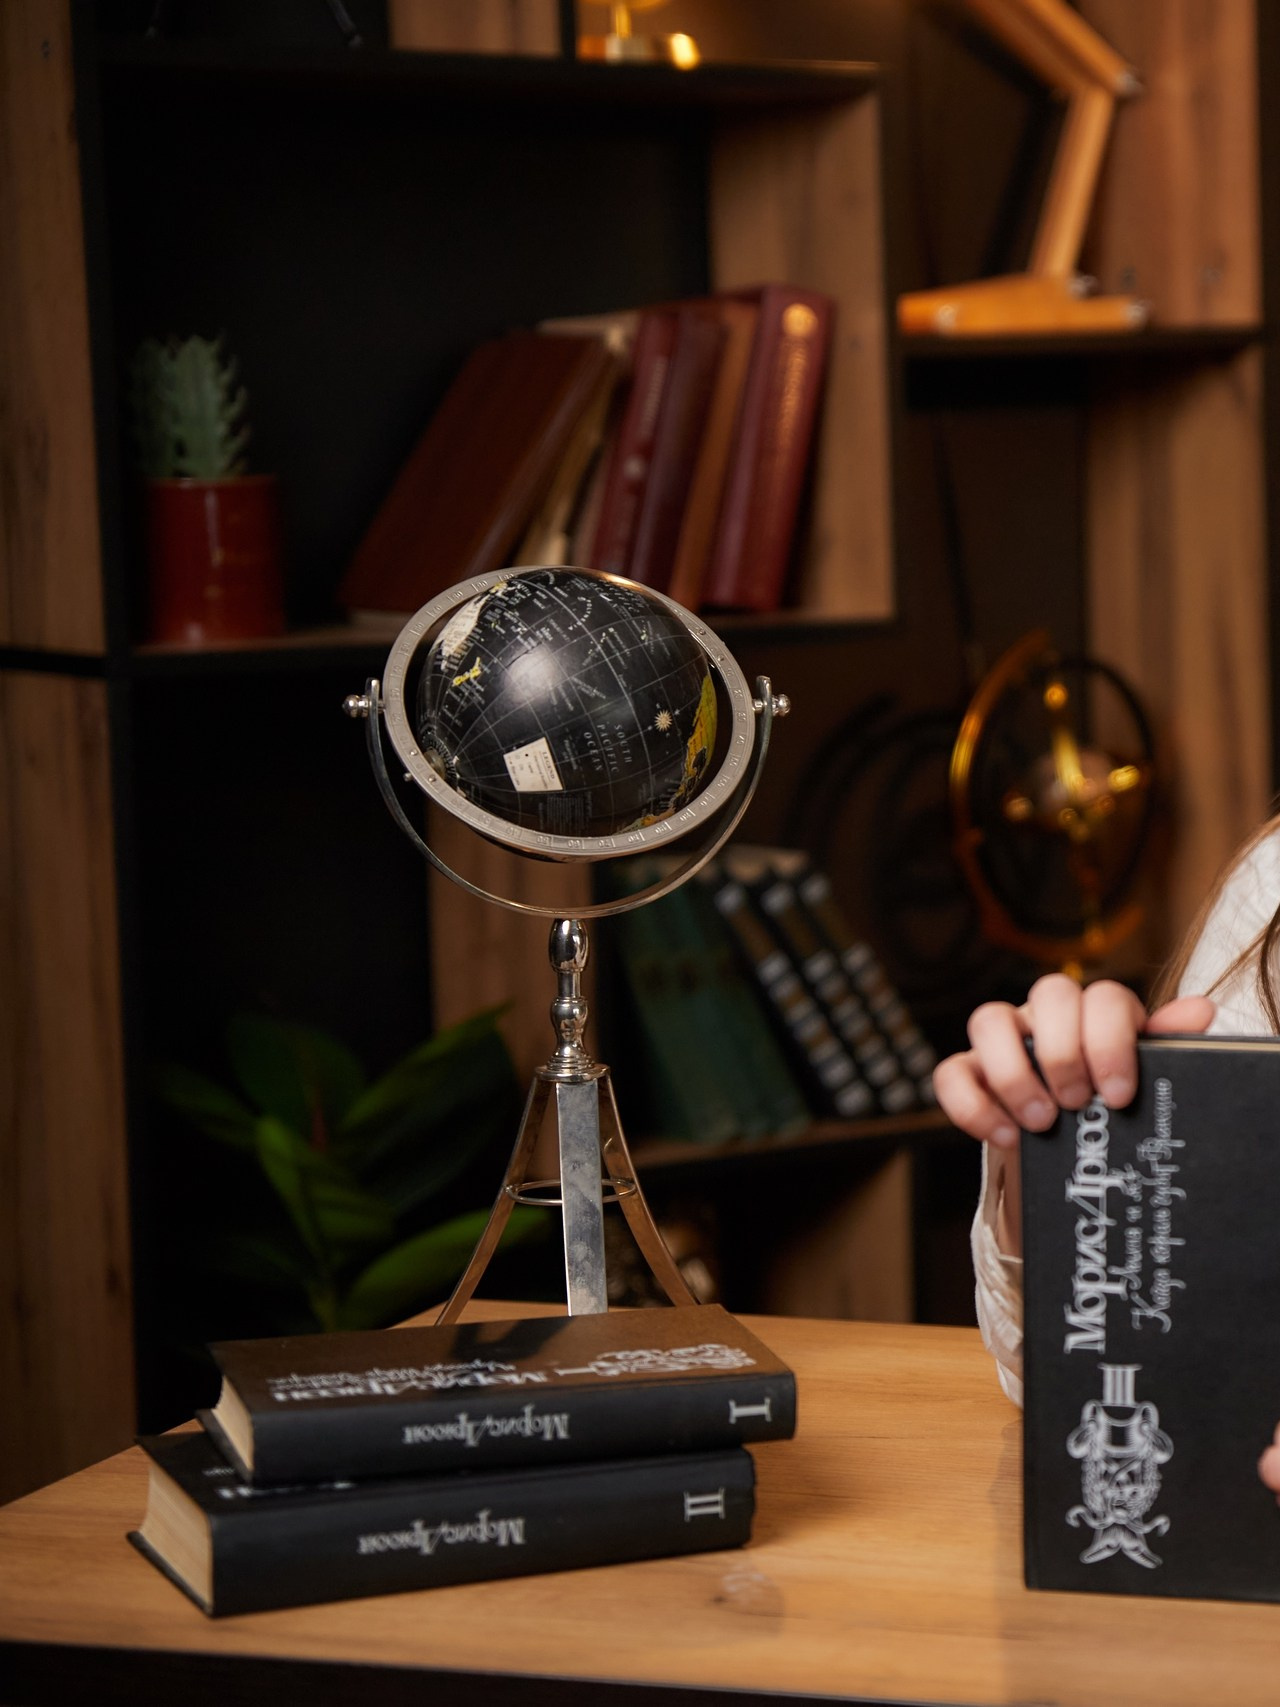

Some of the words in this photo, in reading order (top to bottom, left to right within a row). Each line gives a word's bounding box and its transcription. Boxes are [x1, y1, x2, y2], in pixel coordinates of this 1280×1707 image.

[583, 731, 603, 771] OCEAN
[596, 723, 620, 774] PACIFIC
[613, 723, 633, 764] SOUTH
[542, 751, 555, 781] LEGEND
[1063, 1094, 1127, 1223] Дрюо
[1063, 1216, 1127, 1355] Морис
[401, 1412, 491, 1447] Дрюон
[482, 1404, 570, 1442] Морис
[356, 1517, 448, 1556] Дрюон
[439, 1508, 526, 1547] Морис
